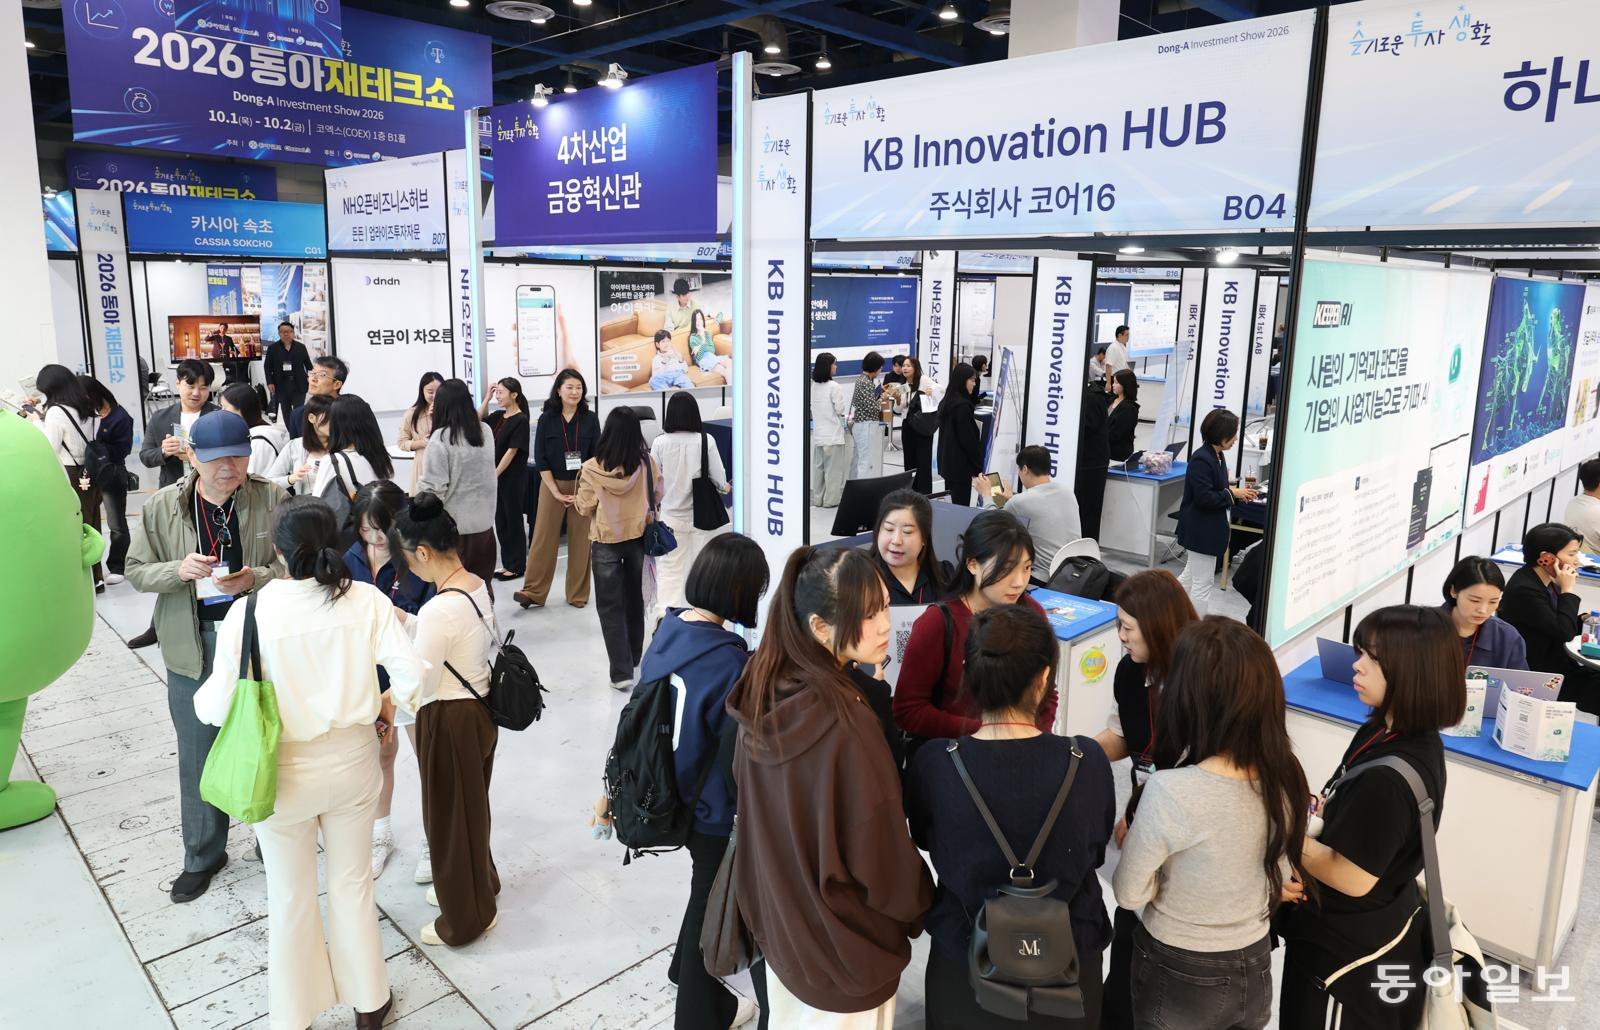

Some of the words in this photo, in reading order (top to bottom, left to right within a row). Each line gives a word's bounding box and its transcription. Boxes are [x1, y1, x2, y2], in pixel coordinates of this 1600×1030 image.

[1157, 41, 1190, 54] Dong-A
[1190, 34, 1239, 50] Investment
[1240, 30, 1266, 42] Show
[1266, 25, 1290, 39] 2026
[1349, 20, 1404, 57] 슬기로운
[1449, 4, 1492, 46] 생활
[131, 26, 245, 80] 2026
[250, 46, 455, 111] 동아재테크쇼
[232, 90, 275, 106] Dong-A
[276, 97, 333, 115] Investment
[333, 104, 362, 118] Show
[362, 108, 385, 121] 2026
[316, 124, 371, 141] 코엑스(COEX)
[557, 122, 627, 166] 4차산업
[863, 136, 904, 173] KB
[913, 117, 1108, 169] Innovation
[1122, 100, 1227, 151] HUB
[342, 187, 430, 216] NH오픈비즈니스허브
[547, 171, 642, 214] 금융혁신관
[929, 185, 1022, 221] 주식회사
[1028, 182, 1116, 216] 코어16
[1222, 193, 1287, 221] B04
[191, 215, 239, 234] 카시아
[242, 218, 274, 235] 속초
[432, 232, 446, 245] B07
[194, 237, 232, 247] CASSIA
[232, 238, 273, 249] SOKCHO
[696, 246, 716, 257] B07
[96, 253, 116, 292] 2026
[373, 276, 401, 286] dndn
[767, 259, 785, 300] KB
[1054, 276, 1073, 306] KB
[1223, 281, 1239, 305] KB
[1188, 304, 1198, 321] IBK
[1258, 304, 1267, 319] IBK
[367, 328, 410, 346] 연금이
[413, 328, 454, 345] 차오른
[928, 280, 943, 384] NH오픈비즈니스
[1187, 323, 1196, 338] 1st
[1254, 336, 1264, 355] LAB
[1044, 312, 1070, 426] Innovation
[1213, 309, 1236, 400] Innovation
[1306, 352, 1345, 389] 사람의
[1346, 349, 1380, 384] 기억과
[766, 310, 785, 465] Innovation
[1304, 396, 1341, 434] 기업의
[766, 479, 785, 537] HUB
